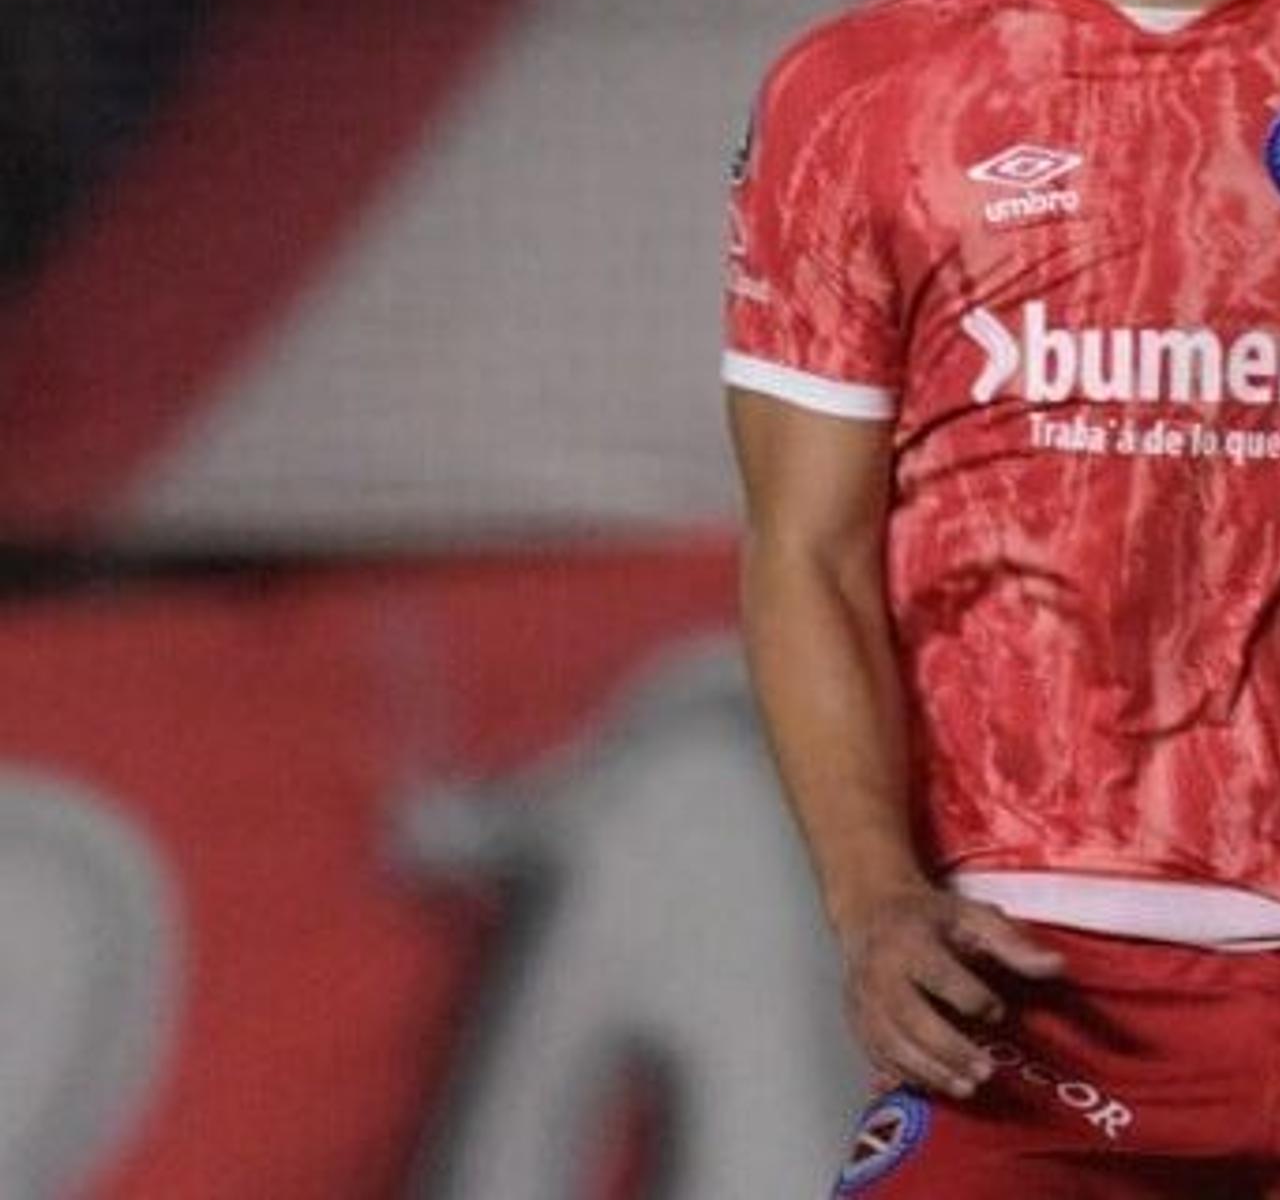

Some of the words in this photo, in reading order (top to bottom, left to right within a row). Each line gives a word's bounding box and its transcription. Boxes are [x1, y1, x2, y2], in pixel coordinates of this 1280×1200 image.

[984, 188, 1080, 224] umbro
[1142, 418, 1184, 459] de
[1191, 422, 1219, 460] lo
